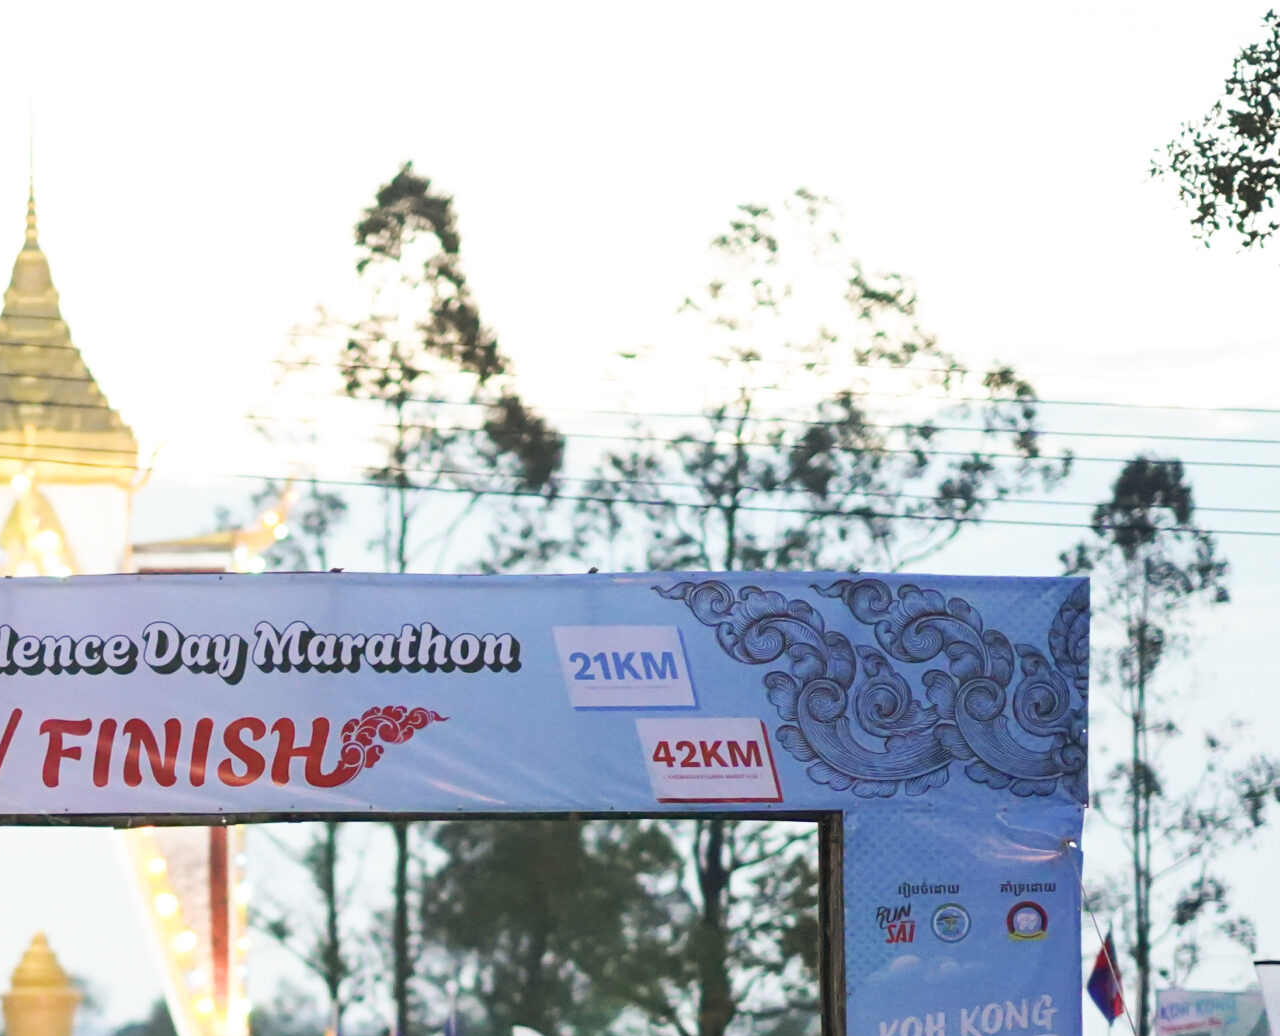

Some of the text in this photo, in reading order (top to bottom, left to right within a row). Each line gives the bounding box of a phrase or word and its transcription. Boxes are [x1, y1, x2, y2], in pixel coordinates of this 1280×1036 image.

[142, 620, 248, 686] Day
[252, 620, 521, 674] Marathon
[569, 651, 679, 681] 21KM
[39, 715, 350, 788] FINISH
[652, 740, 763, 768] 42KM
[875, 903, 912, 929] RUN
[885, 923, 916, 943] SAI
